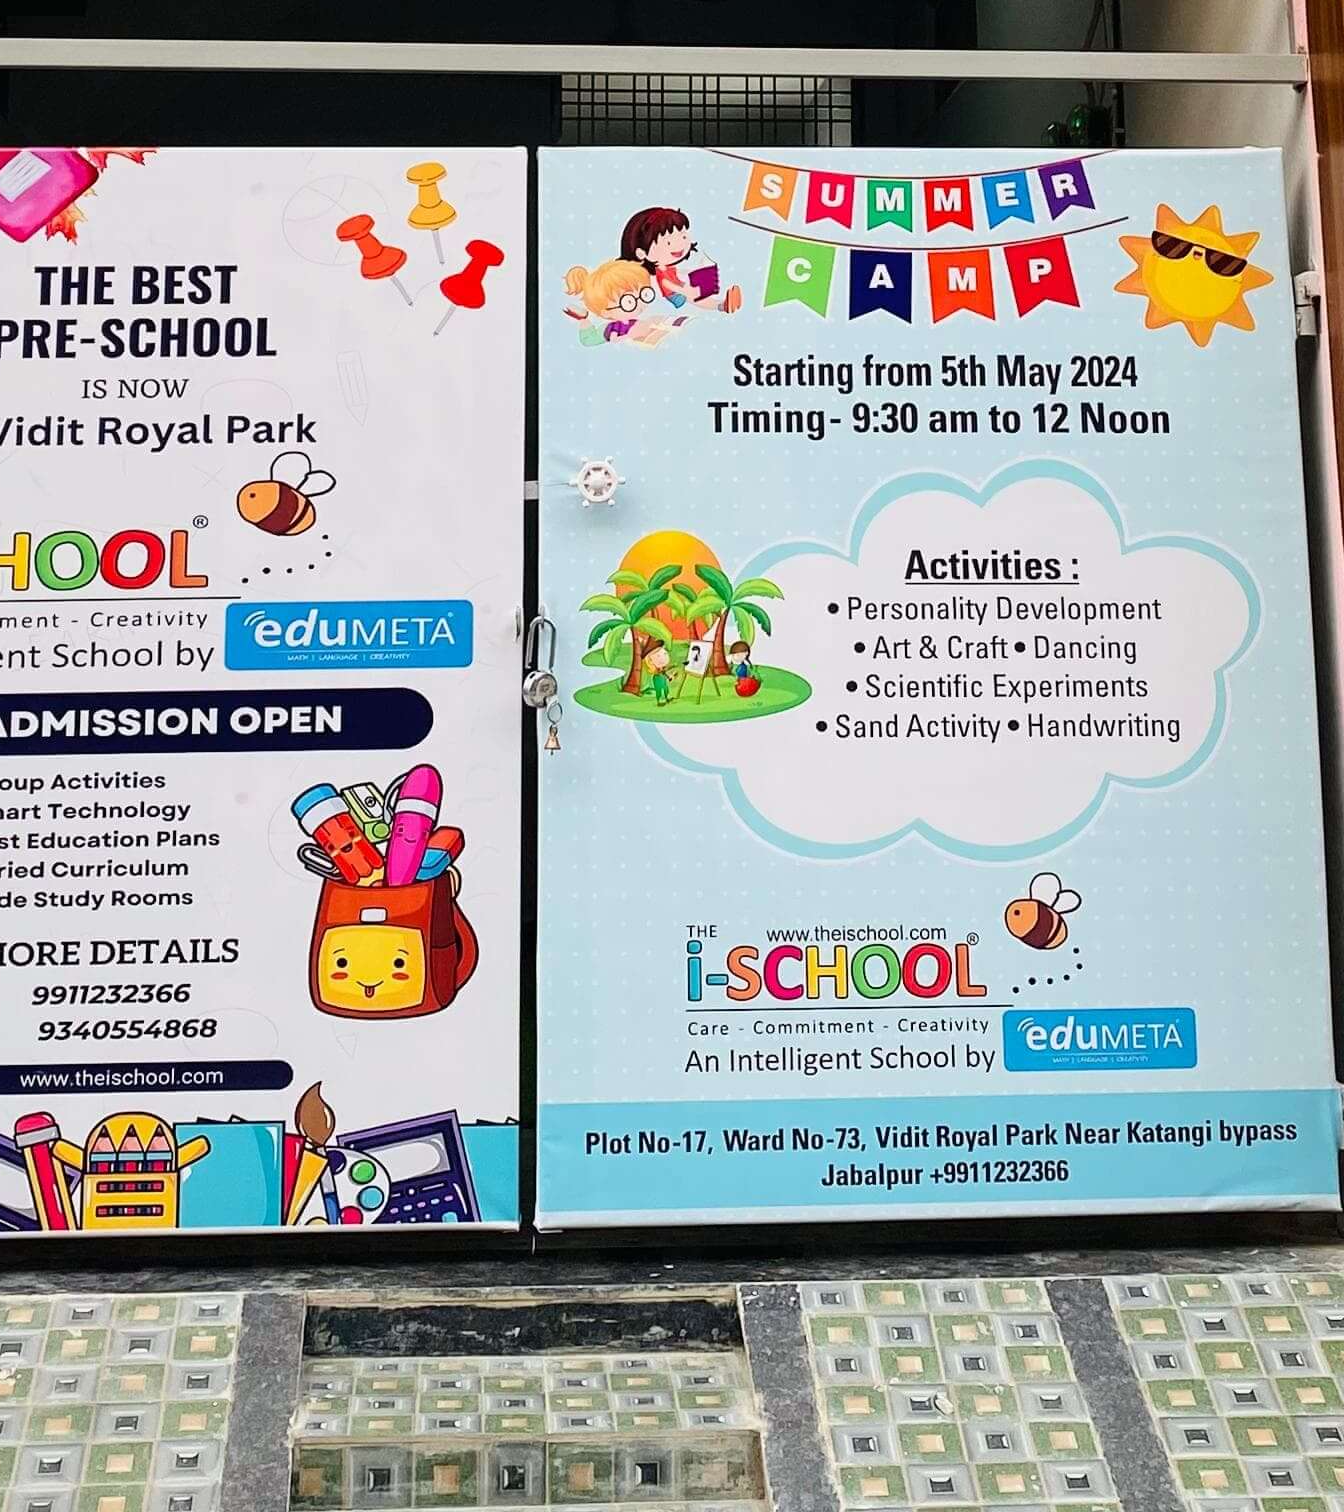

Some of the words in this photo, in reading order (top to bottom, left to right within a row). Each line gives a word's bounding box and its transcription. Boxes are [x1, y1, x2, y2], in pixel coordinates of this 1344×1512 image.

[759, 173, 1078, 211] SUMMER
[34, 265, 115, 306] THE
[132, 266, 237, 304] BEST
[787, 257, 1053, 292] CAMP
[734, 354, 853, 394] Starting
[863, 354, 931, 386] from
[942, 355, 986, 386] 5th
[997, 355, 1061, 394] May
[1071, 356, 1137, 387] 2024
[82, 380, 106, 399] IS
[118, 379, 188, 398] NOW
[853, 403, 917, 433] 9:30
[929, 411, 977, 432] am
[989, 406, 1020, 433] to
[1033, 403, 1069, 433] 12
[1081, 403, 1169, 433] Noon
[99, 415, 212, 452] Royal
[228, 414, 316, 443] Park
[905, 550, 1060, 579] Activities
[91, 611, 207, 629] Creativity
[848, 597, 987, 625] Personality
[997, 597, 1161, 625] Development
[255, 608, 455, 647] eduMETA
[52, 641, 162, 667] School
[177, 640, 214, 672] by
[873, 636, 911, 659] Art
[920, 636, 938, 659] &
[949, 636, 1008, 659] Craft
[1035, 636, 1136, 664] Dancing
[866, 674, 982, 697] Scientific
[994, 674, 1147, 703] Experiments
[229, 705, 342, 736] OPEN
[836, 714, 898, 738] Sand
[906, 714, 1000, 743] Activity
[1029, 713, 1179, 742] Handwriting
[51, 772, 165, 789] Activities
[48, 801, 190, 821] Technology
[28, 831, 148, 848] Education
[157, 830, 219, 846] Plans
[52, 860, 188, 877] Curriculum
[34, 890, 104, 910] Study
[112, 891, 192, 906] Rooms
[686, 925, 717, 937] THE
[767, 925, 946, 942] www.theischool.com
[90, 939, 238, 965] DETAILS
[686, 941, 987, 1002] i-SCHOOL
[32, 984, 191, 1005] 9911232366
[38, 1019, 217, 1040] 9340554868
[688, 1022, 728, 1035] Care
[754, 1021, 874, 1034] Commitment
[898, 1019, 988, 1034] Creativity
[1025, 1015, 1182, 1050] eduMETA
[685, 1051, 718, 1072] An
[731, 1047, 861, 1075] Intelligent
[871, 1045, 955, 1068] School
[967, 1044, 995, 1072] by
[20, 1067, 224, 1089] www.theischool.com
[587, 1133, 631, 1154] Plot
[639, 1131, 712, 1154] No-17,
[723, 1129, 784, 1151] Ward
[793, 1128, 865, 1151] No-73,
[876, 1126, 929, 1148] Vidit
[936, 1125, 997, 1152] Royal
[1006, 1124, 1057, 1145] Park
[1066, 1123, 1120, 1144] Near
[1127, 1120, 1211, 1146] Katangi
[1220, 1120, 1296, 1146] bypass
[822, 1163, 923, 1190] Jabalpur
[930, 1160, 1068, 1183] +9911232366
